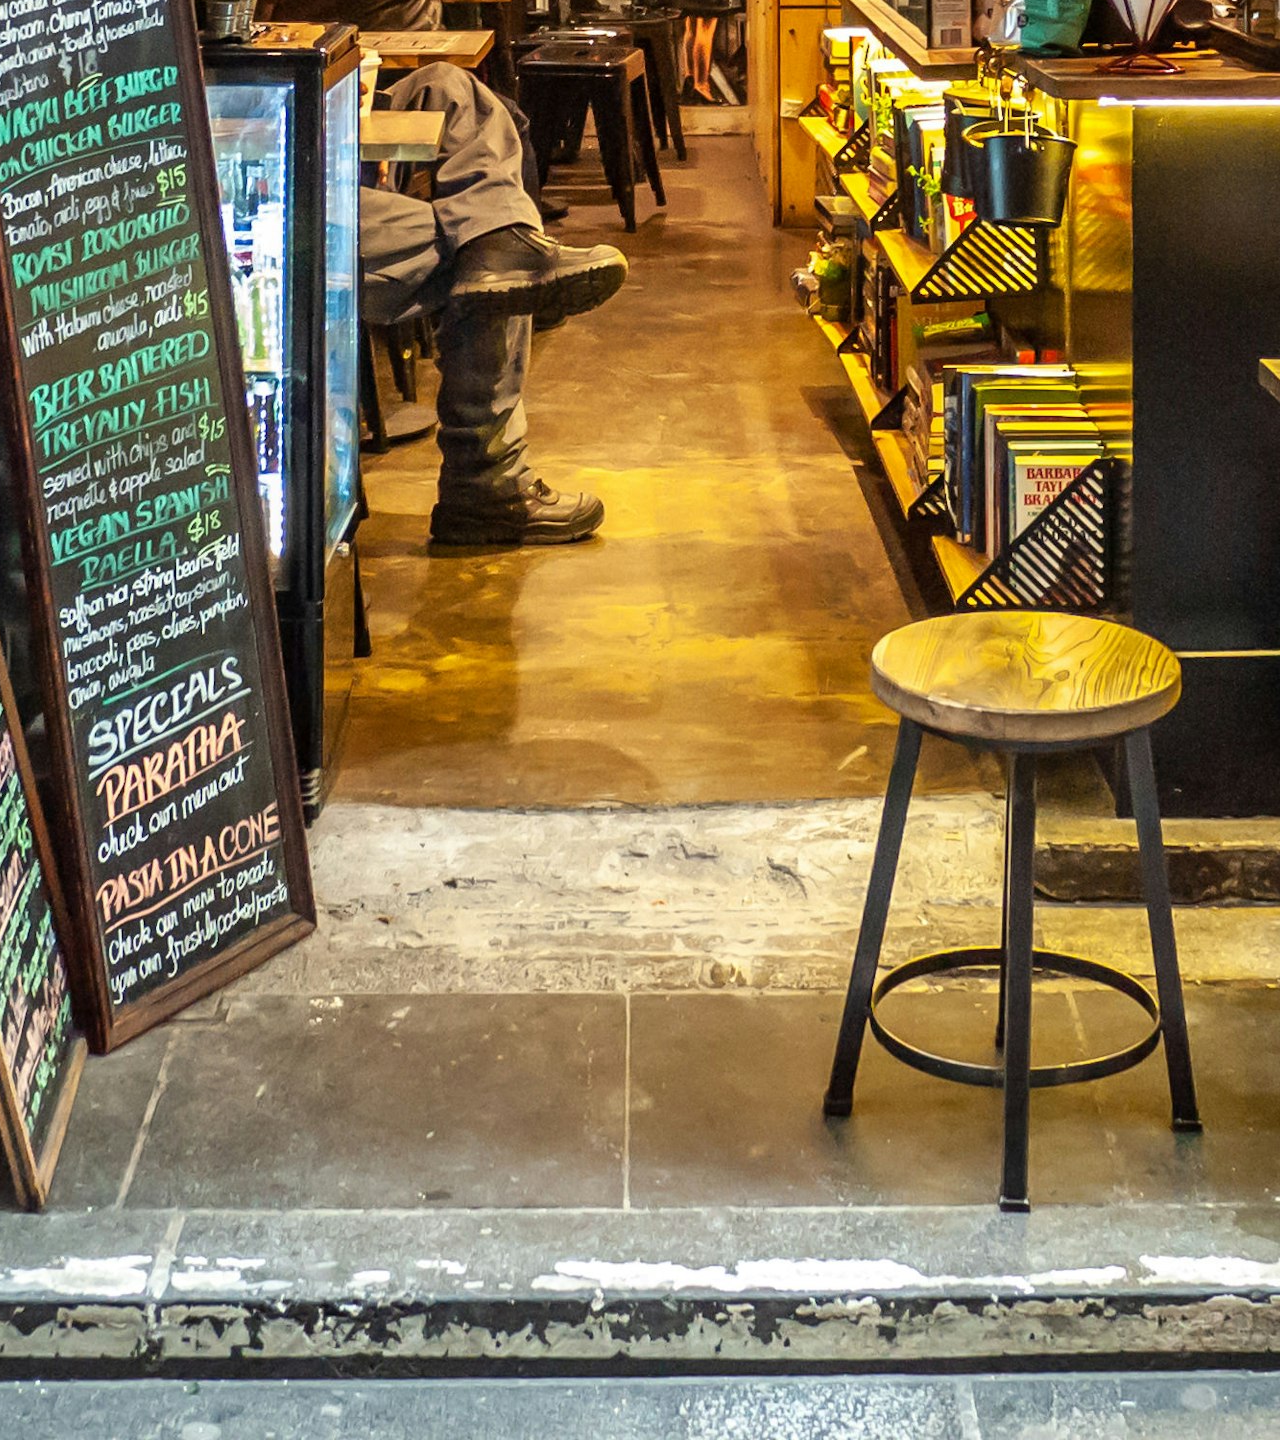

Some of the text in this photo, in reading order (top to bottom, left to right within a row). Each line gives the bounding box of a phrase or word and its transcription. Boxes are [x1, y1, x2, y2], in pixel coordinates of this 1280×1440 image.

[21, 102, 182, 173] CHICKEN BURGER
[64, 77, 114, 120] BEEF
[12, 238, 74, 288] ROAST
[134, 232, 200, 278] BURGER
[29, 330, 210, 428] BEER BATTERED
[35, 377, 210, 458] TREVALLY FISH
[51, 474, 229, 561] VEGAN SPANISH
[78, 530, 178, 587] PAELLA
[88, 657, 243, 766] SPECIALS
[96, 711, 246, 820] PARATHA
[95, 801, 282, 923] PASTA IN A CONE
